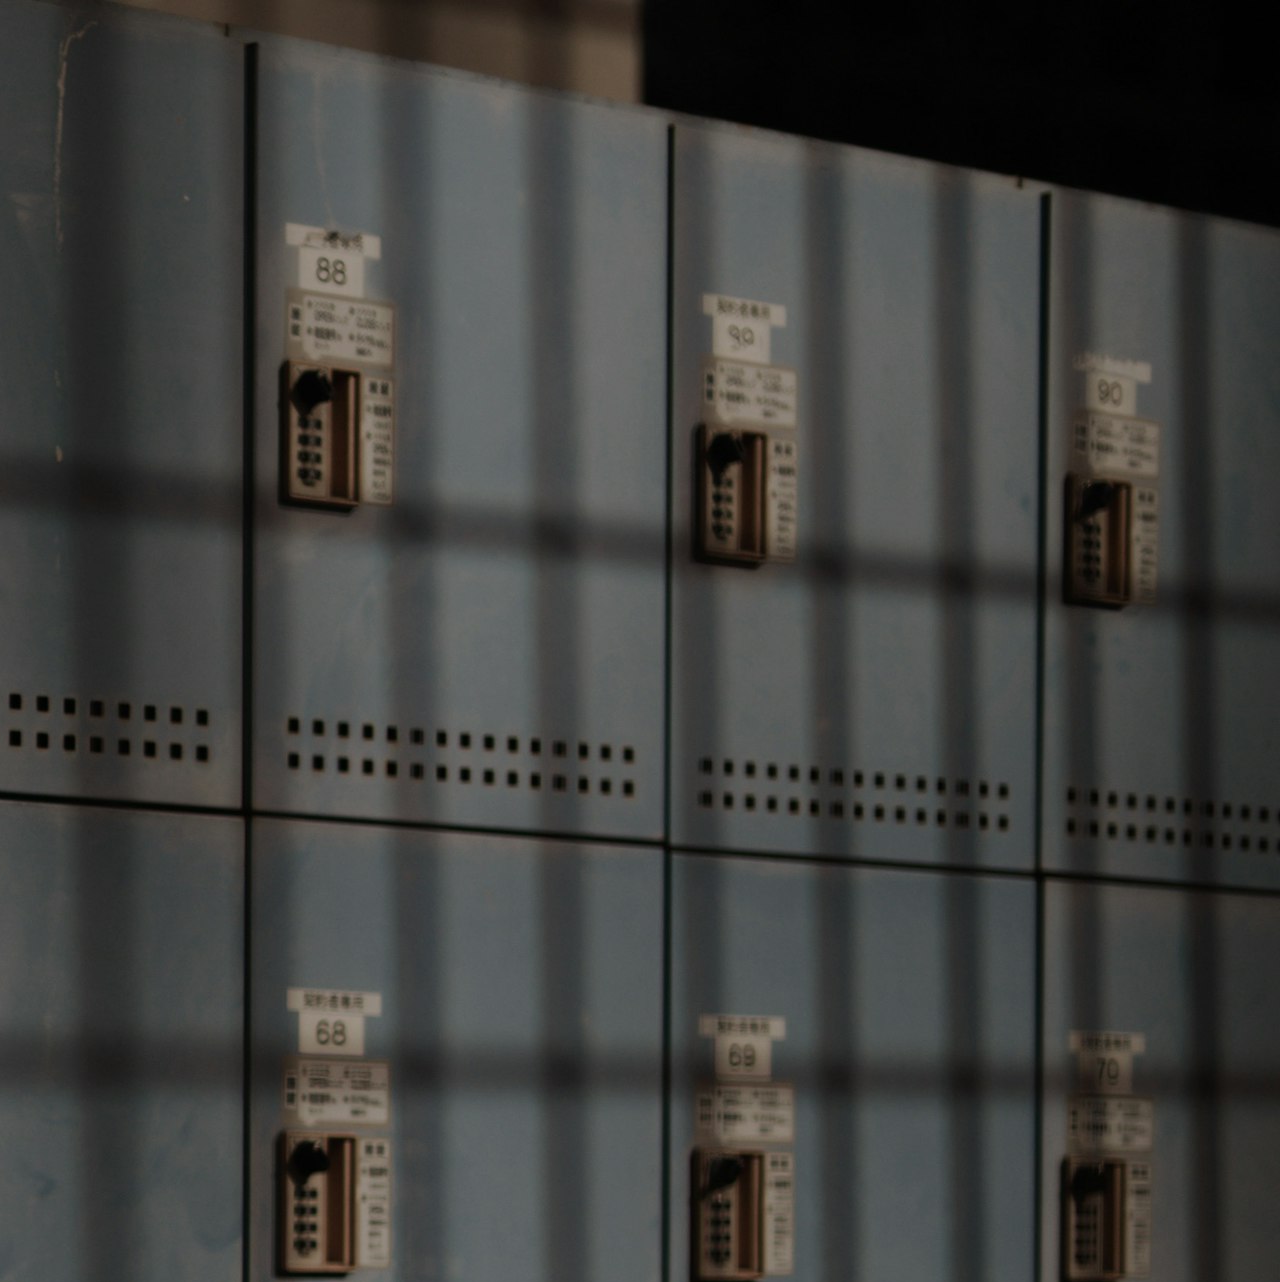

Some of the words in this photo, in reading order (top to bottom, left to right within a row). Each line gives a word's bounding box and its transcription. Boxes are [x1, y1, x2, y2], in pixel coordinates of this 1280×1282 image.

[316, 256, 346, 285] 88
[1098, 379, 1122, 406] 90
[316, 1019, 346, 1046] 68
[728, 1043, 756, 1067] 69
[1096, 1058, 1119, 1085] 70
